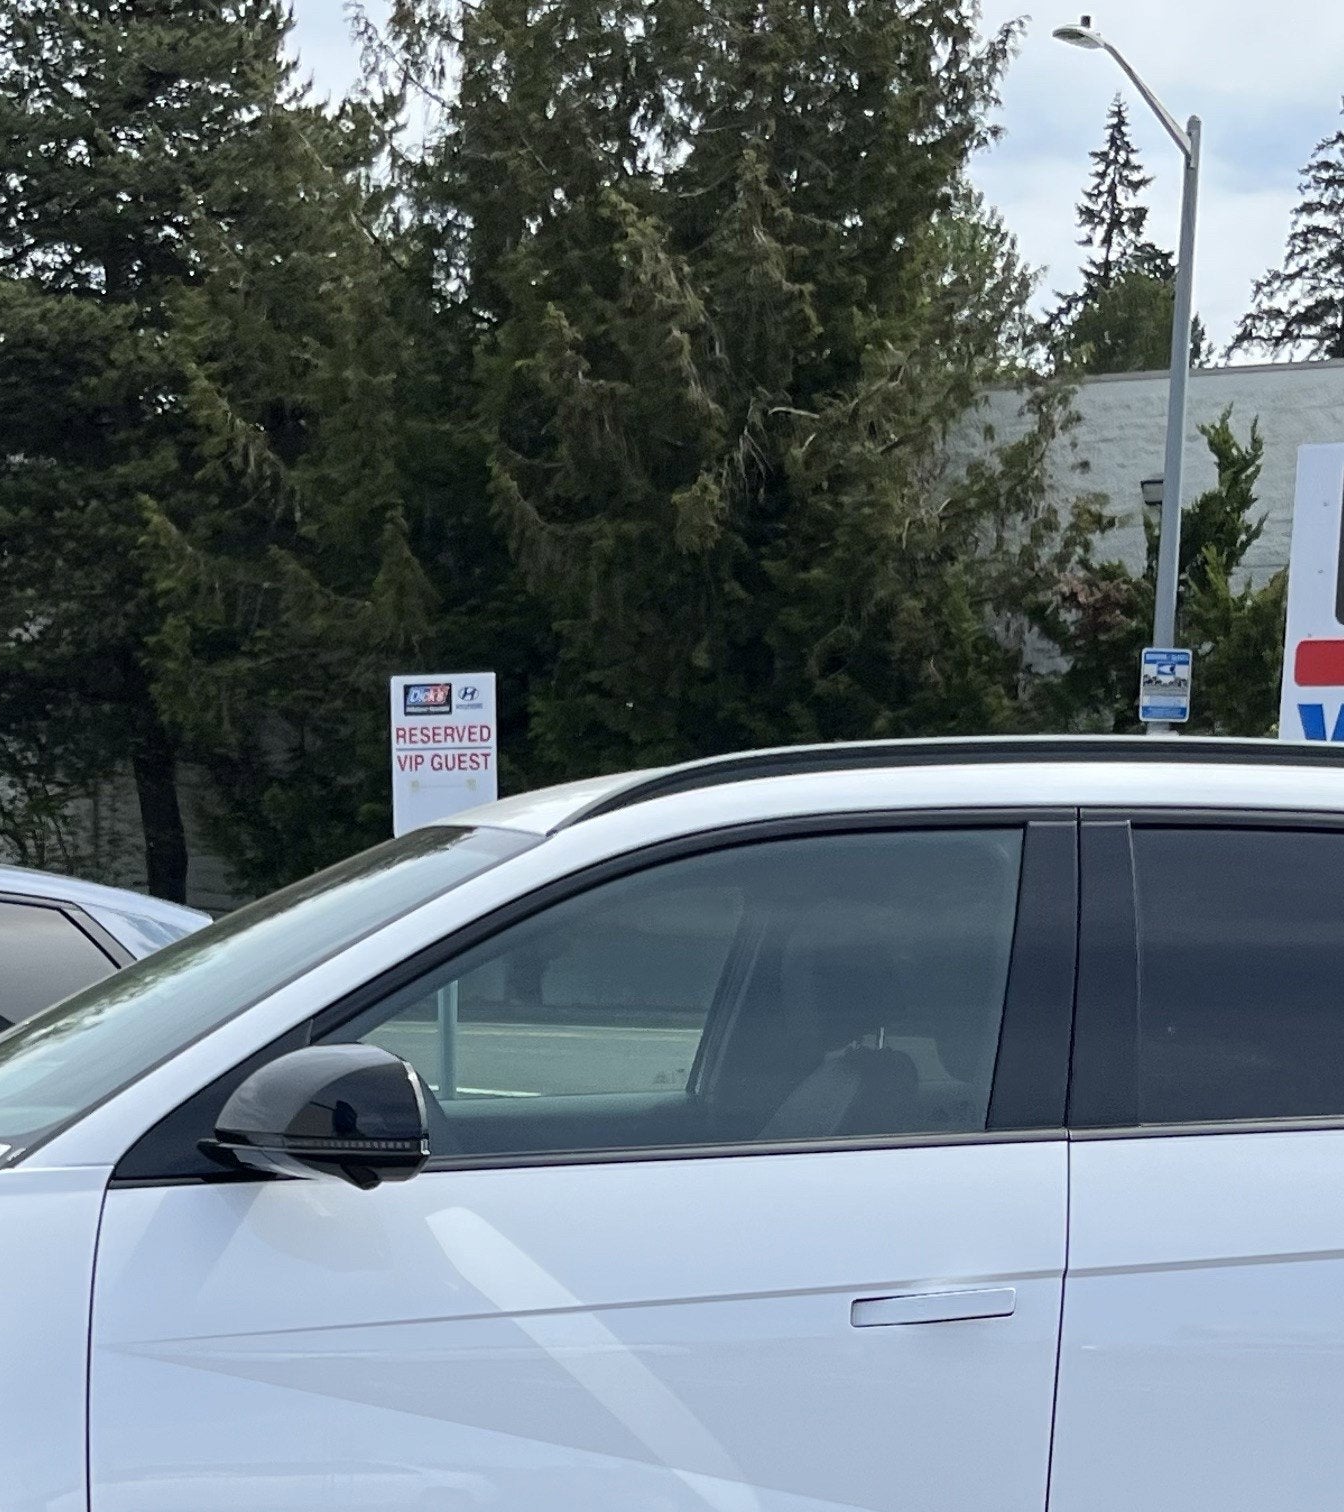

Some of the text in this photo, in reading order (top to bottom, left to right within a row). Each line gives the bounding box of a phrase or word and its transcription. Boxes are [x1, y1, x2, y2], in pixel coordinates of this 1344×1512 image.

[396, 725, 492, 745] RESERVED
[396, 753, 491, 772] VIP GUEST
